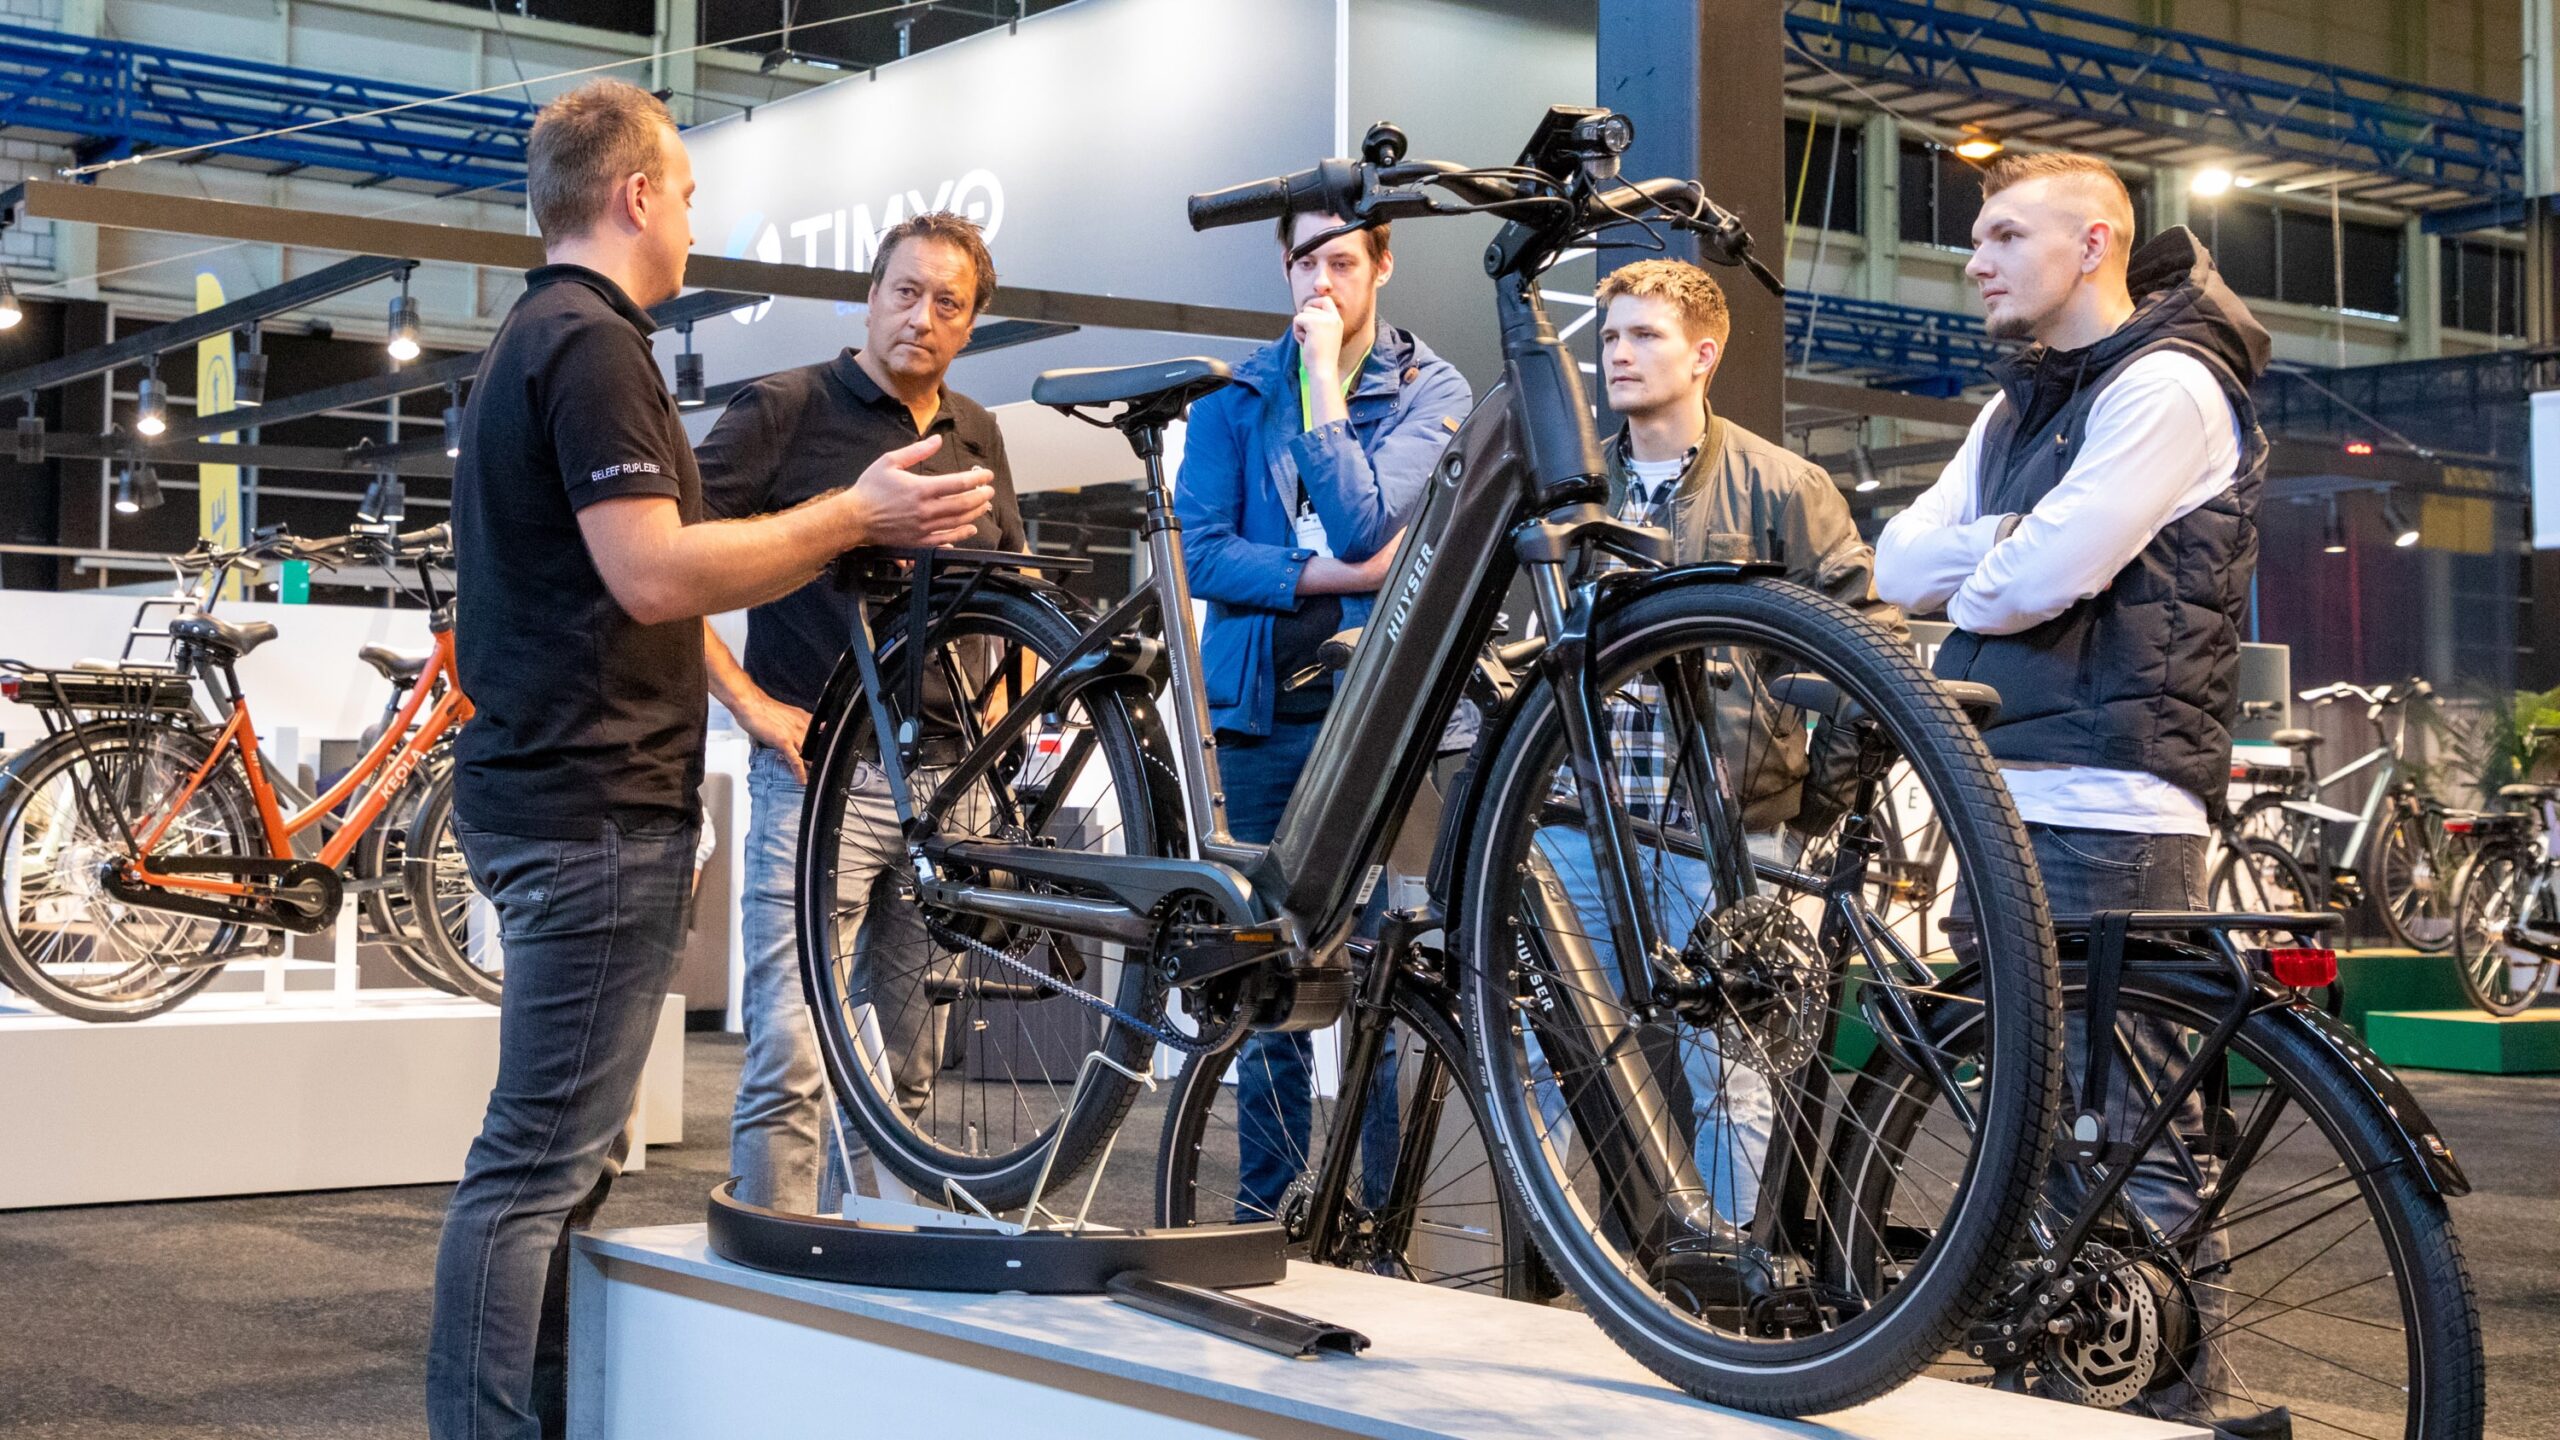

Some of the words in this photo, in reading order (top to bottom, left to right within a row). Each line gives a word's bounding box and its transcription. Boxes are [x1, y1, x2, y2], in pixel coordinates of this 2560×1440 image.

[592, 465, 620, 481] BELEEF
[1387, 543, 1434, 642] HUYSER
[380, 750, 425, 801] KEOLA
[1503, 1148, 1541, 1223] SCHWALBE
